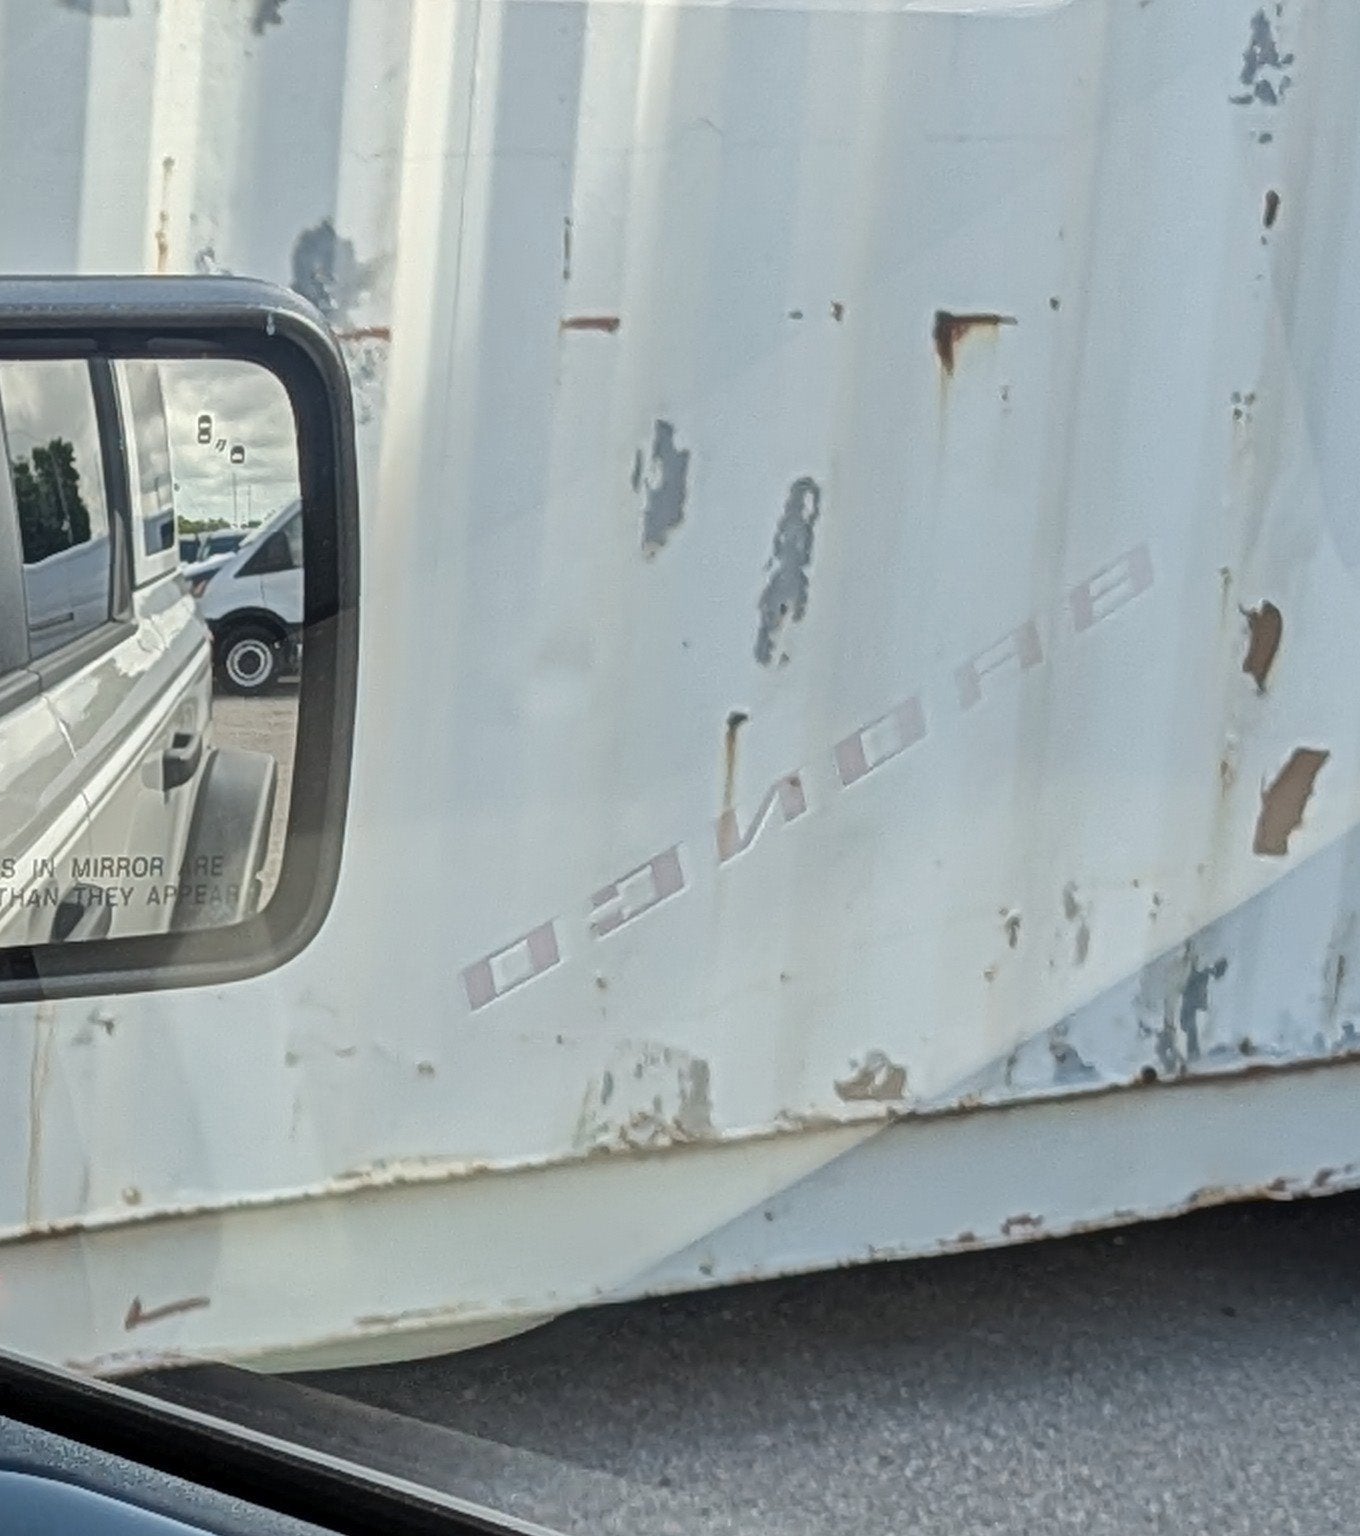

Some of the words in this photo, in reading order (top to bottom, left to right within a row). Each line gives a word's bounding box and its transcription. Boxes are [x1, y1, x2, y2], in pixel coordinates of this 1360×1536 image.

[32, 857, 55, 878] IN
[71, 856, 165, 878] MIRROR
[178, 855, 224, 877] ARE
[73, 886, 133, 908] THEY
